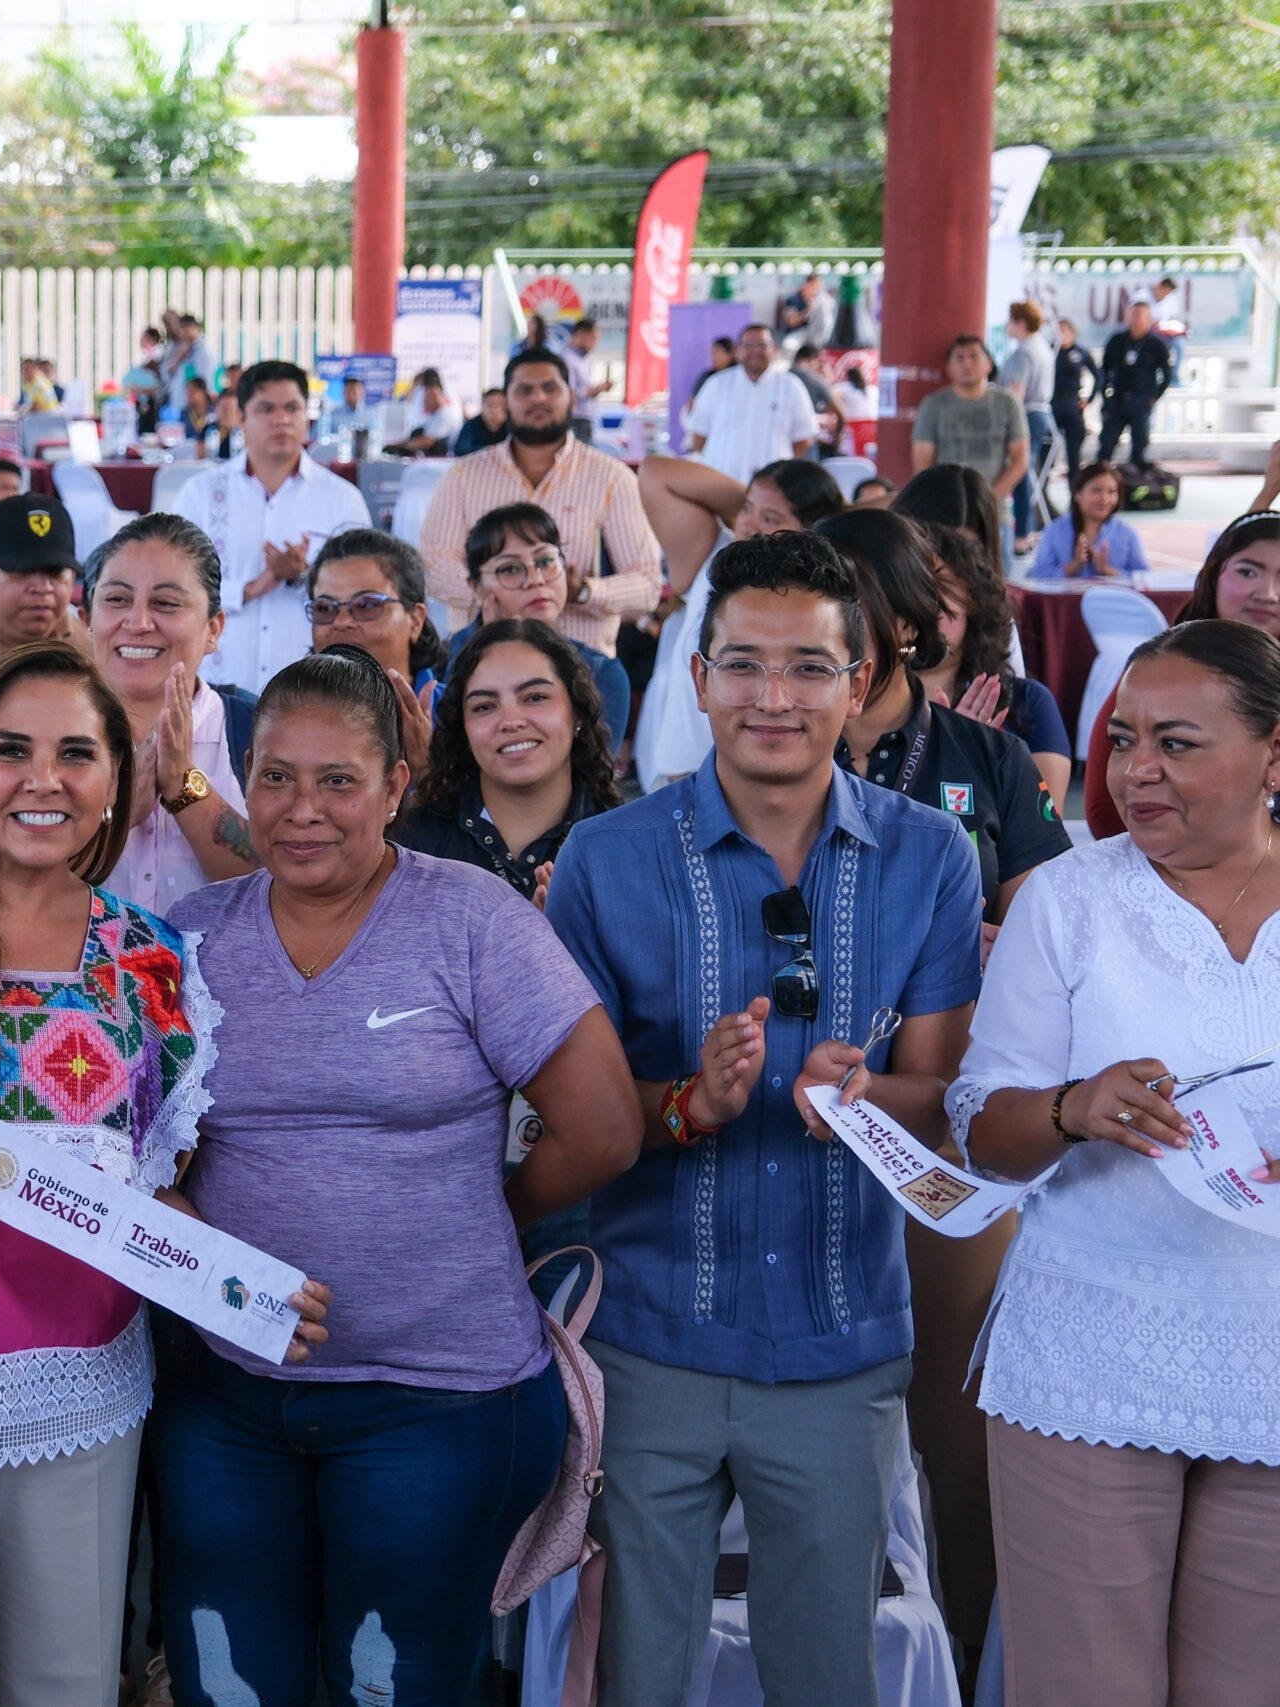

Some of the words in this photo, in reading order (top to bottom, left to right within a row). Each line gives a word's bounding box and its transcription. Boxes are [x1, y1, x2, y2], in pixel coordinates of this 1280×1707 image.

[641, 215, 684, 358] Coca-Cola
[902, 731, 926, 780] MÉXICO
[828, 1106, 840, 1118] en
[840, 1119, 850, 1128] el
[850, 1128, 879, 1157] marco
[880, 1159, 892, 1171] de
[892, 1172, 902, 1182] la
[847, 1101, 924, 1170] Empléate
[862, 1127, 912, 1176] Mujer
[1192, 1110, 1220, 1150] STYPS
[18, 1179, 101, 1234] México
[28, 1168, 90, 1206] Gobierno
[92, 1202, 108, 1216] de
[926, 1179, 959, 1200] MUJERES
[1226, 1168, 1264, 1205] SEECAT
[131, 1224, 198, 1270] Trabajo
[255, 1292, 288, 1316] SNE
